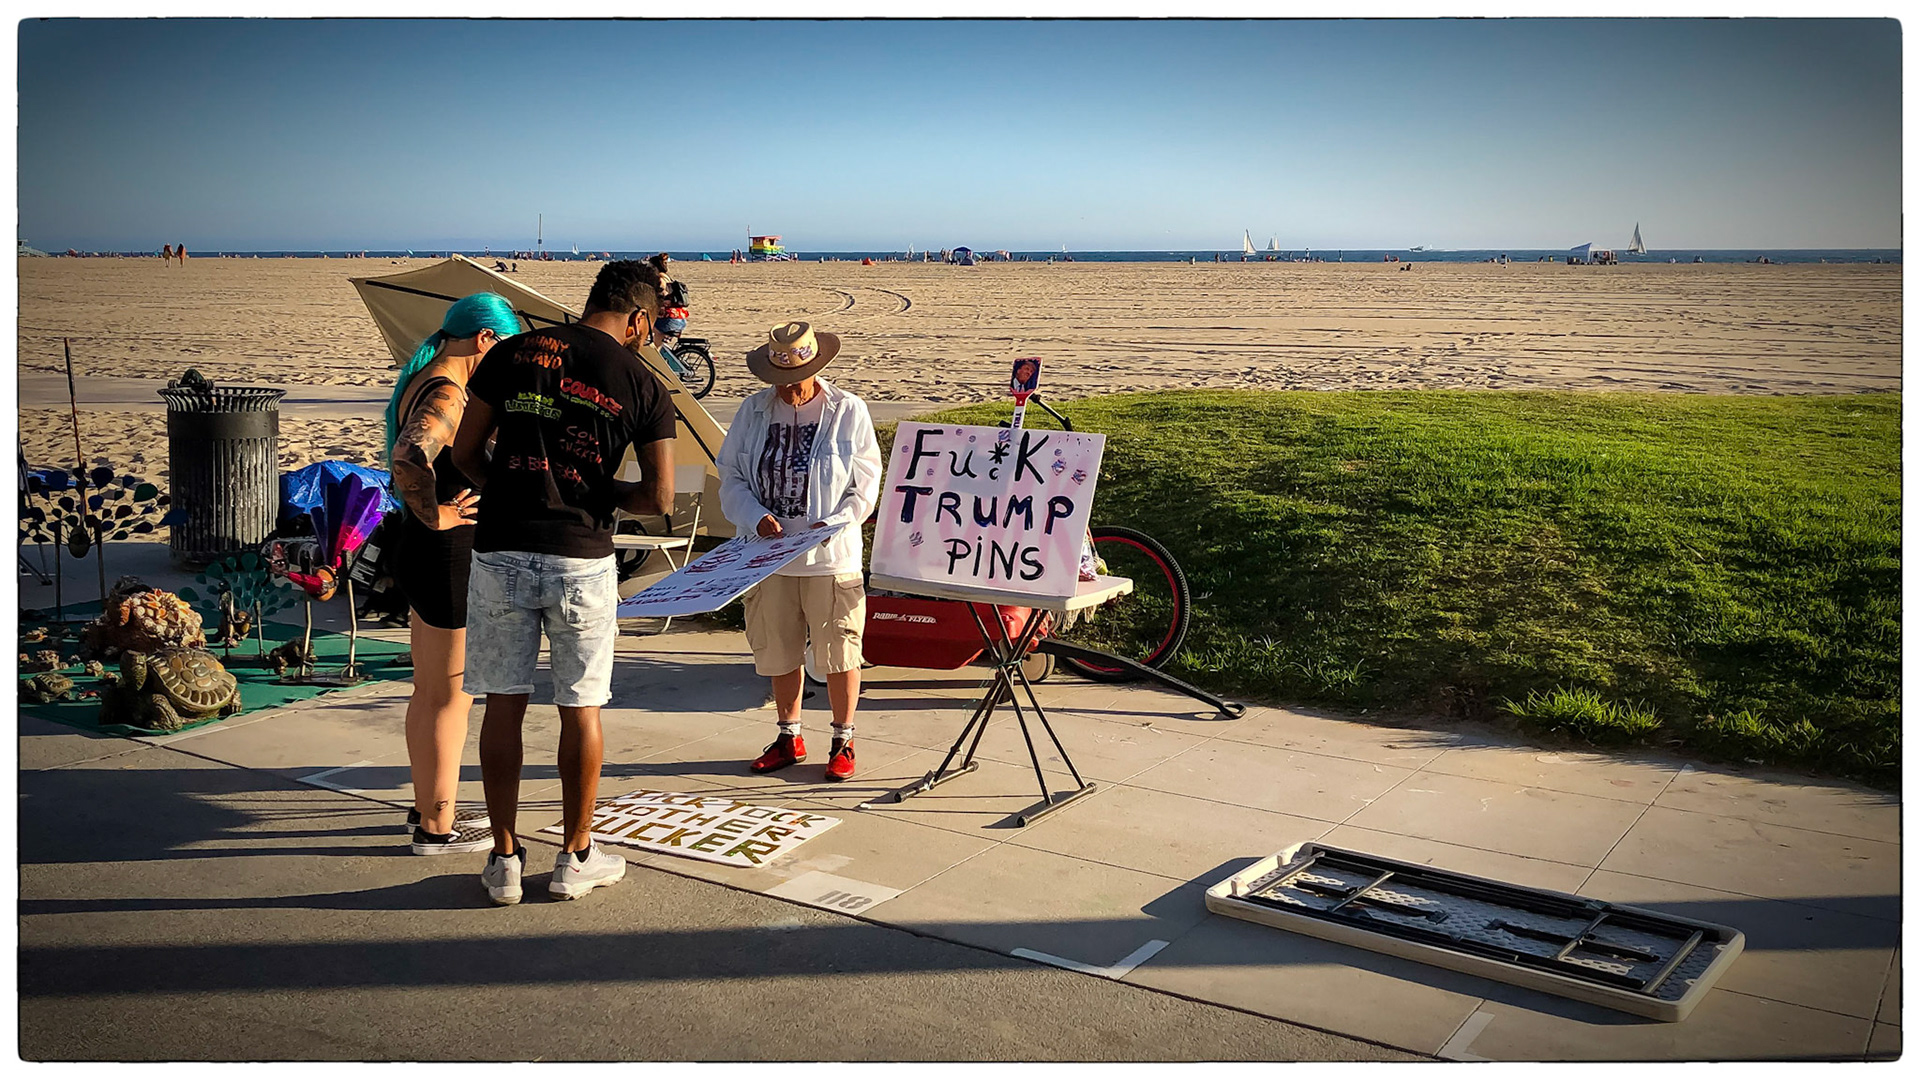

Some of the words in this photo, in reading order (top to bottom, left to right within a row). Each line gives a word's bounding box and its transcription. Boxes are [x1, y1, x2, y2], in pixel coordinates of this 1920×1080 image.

[895, 485, 1075, 535] TRUMP
[906, 614, 938, 624] FLYER
[722, 800, 826, 828] TOCK
